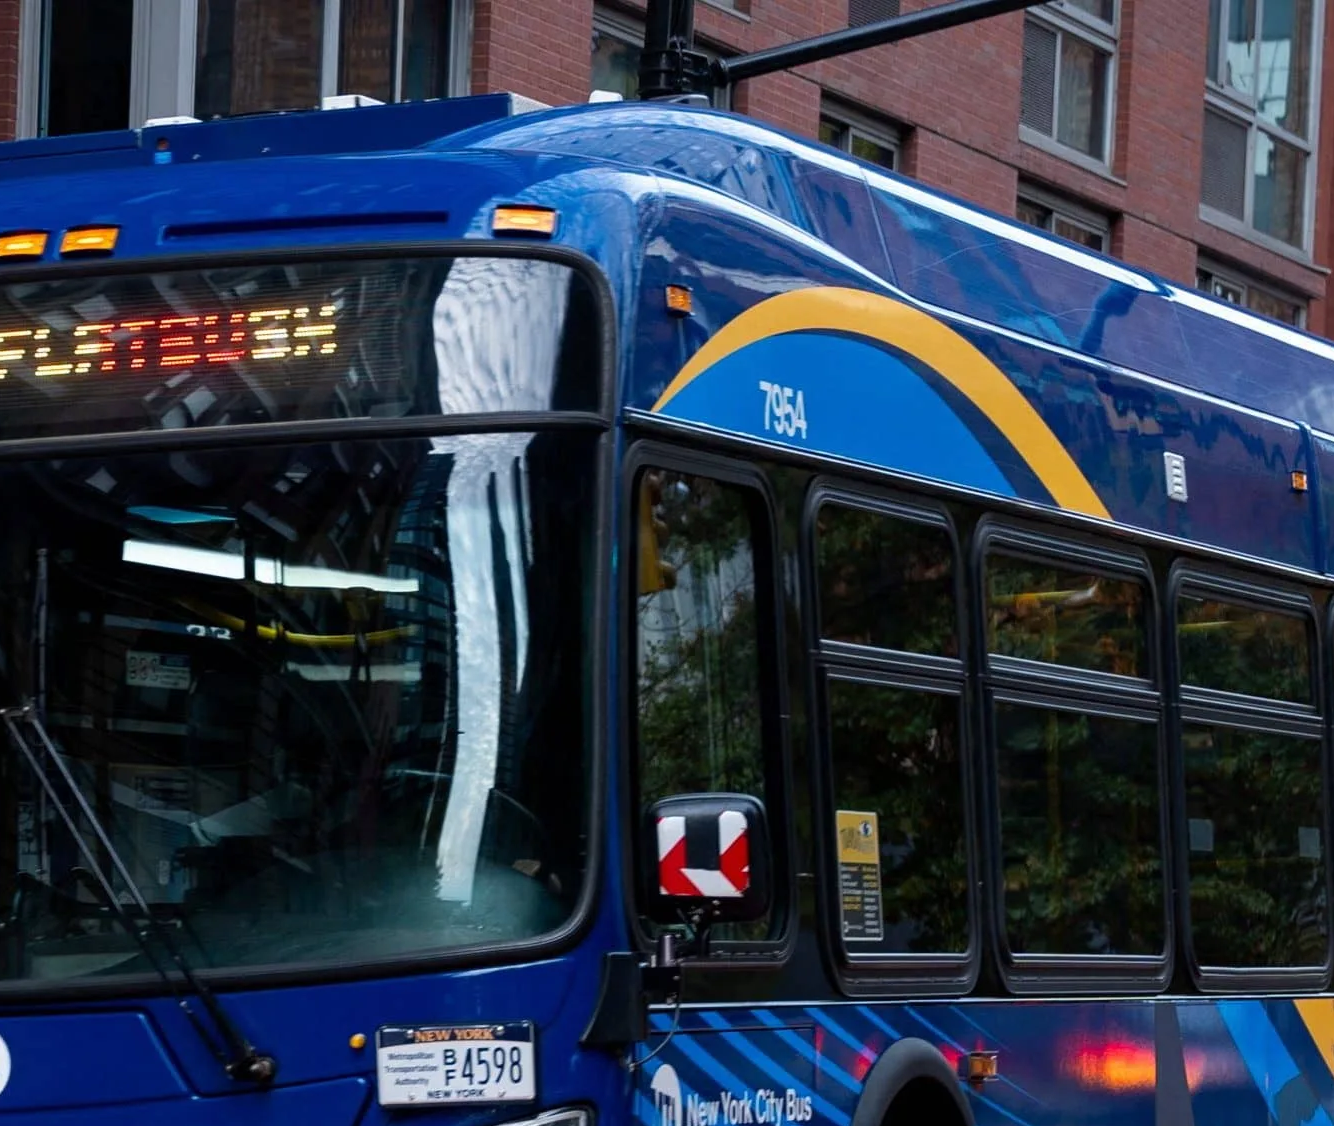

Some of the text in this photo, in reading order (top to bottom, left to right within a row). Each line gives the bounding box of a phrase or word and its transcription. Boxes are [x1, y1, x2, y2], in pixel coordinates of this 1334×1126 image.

[759, 380, 808, 439] 7954
[415, 1028, 495, 1043] NEW YORK
[427, 1088, 485, 1099] NEW YORK
[720, 1090, 754, 1126] York
[786, 1088, 813, 1122] Bus
